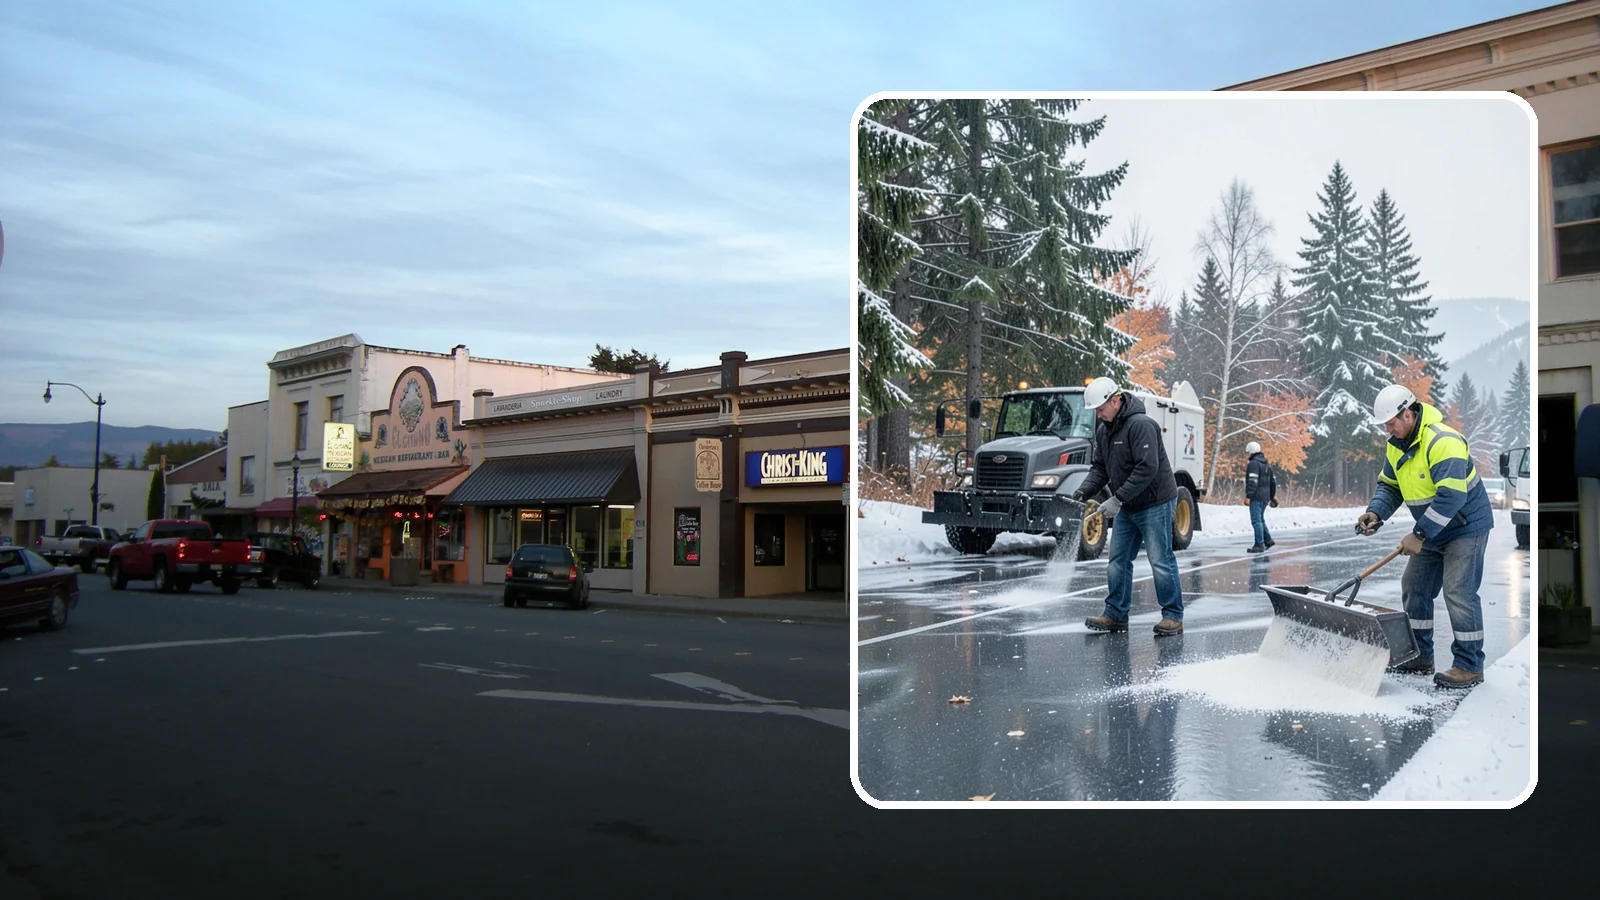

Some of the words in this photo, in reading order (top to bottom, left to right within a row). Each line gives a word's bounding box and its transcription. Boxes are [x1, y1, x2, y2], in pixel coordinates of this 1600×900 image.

[595, 389, 623, 399] LAUNDRY
[493, 401, 522, 412] LAVANDERIA
[531, 397, 561, 409] Sparkle
[561, 394, 582, 405] Shop
[392, 425, 401, 449] EL
[373, 455, 396, 464] MEXICAN
[398, 452, 433, 462] RESTAURANT
[438, 450, 450, 459] BAR
[761, 452, 797, 478] CHRIST
[799, 450, 827, 476] KING
[696, 480, 709, 489] Coffee
[710, 480, 721, 488] House
